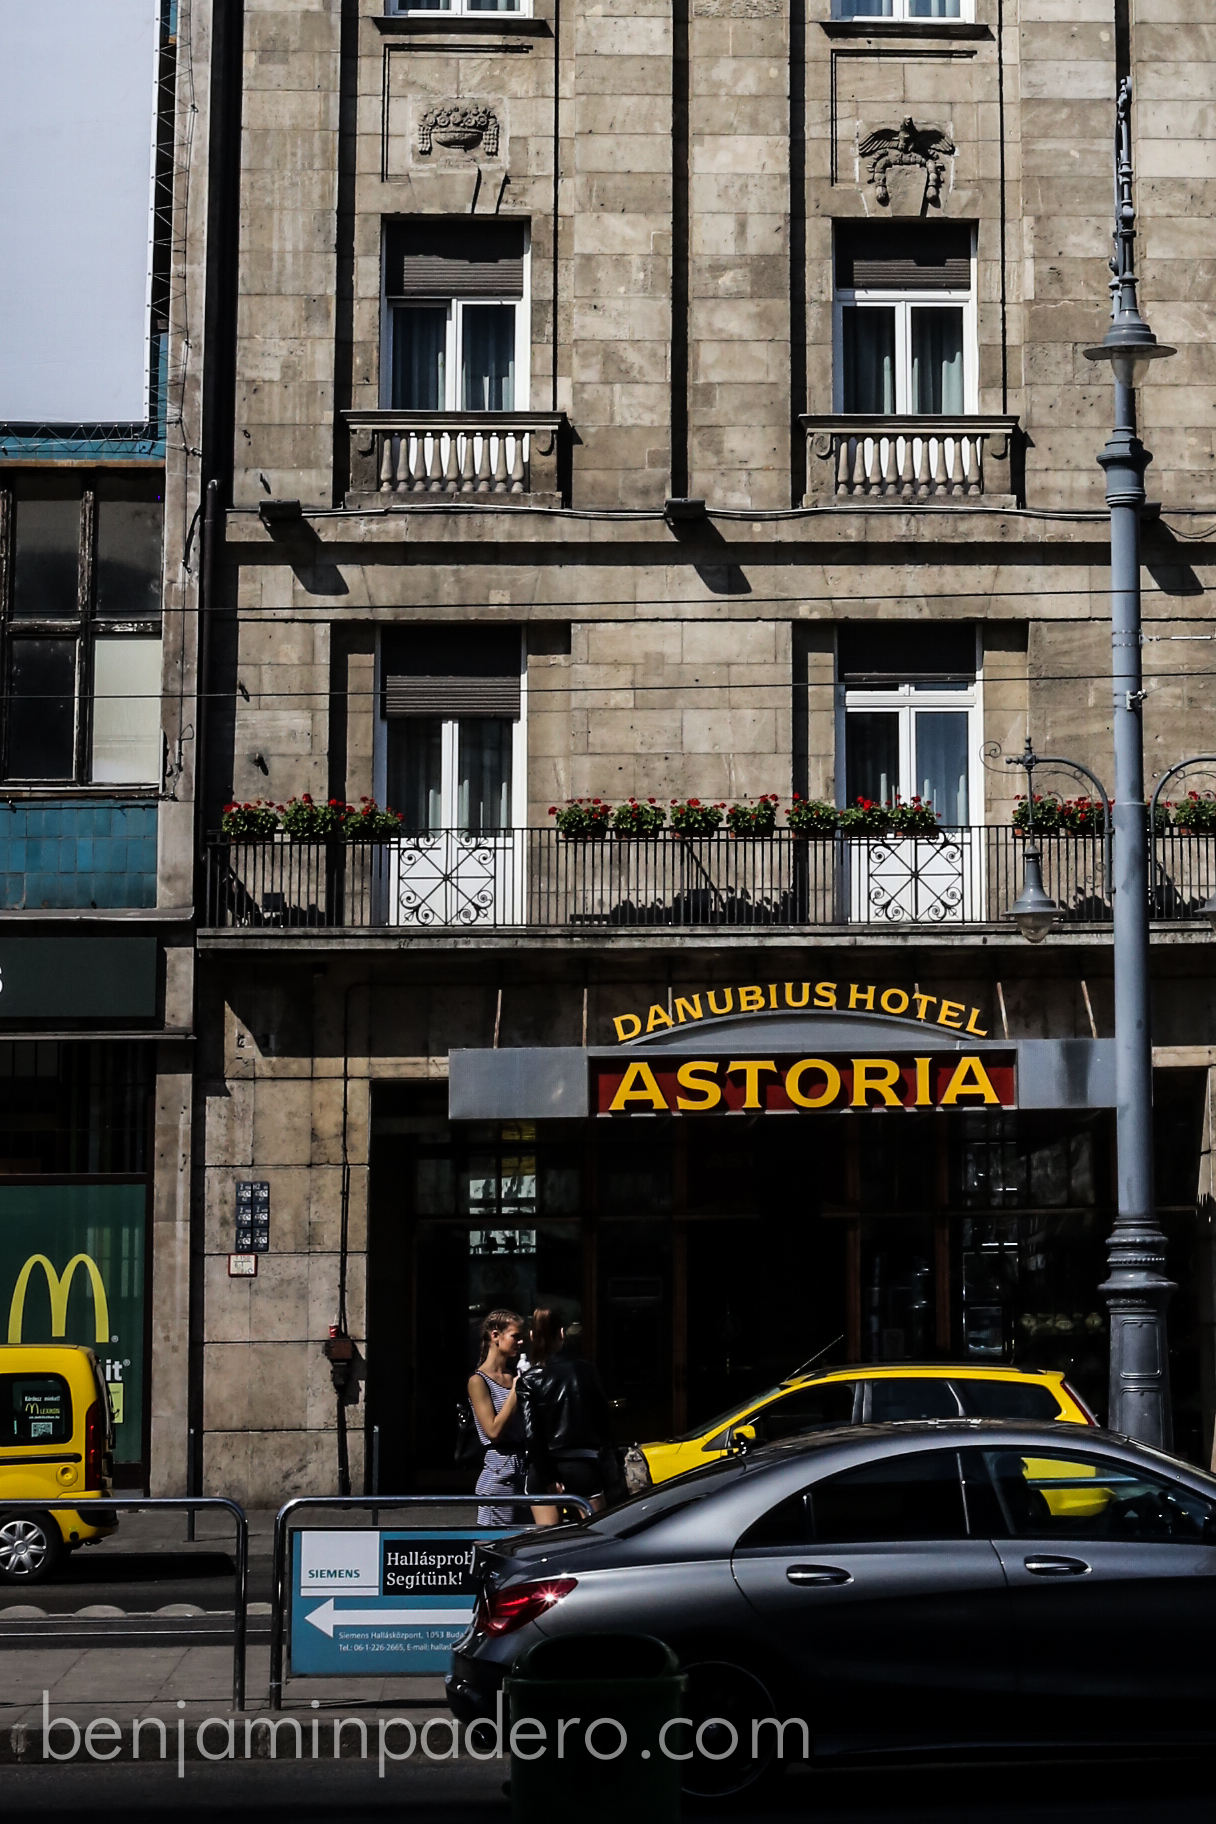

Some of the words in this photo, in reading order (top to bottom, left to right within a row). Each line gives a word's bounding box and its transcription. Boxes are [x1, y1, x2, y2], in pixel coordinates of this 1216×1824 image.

[611, 981, 838, 1043] DANUBIUS
[847, 983, 990, 1038] HOTEL
[606, 1055, 1001, 1111] ASTORIA
[308, 1568, 361, 1579] SIEMENS
[386, 1570, 463, 1589] Segítünk!
[338, 1631, 369, 1639] Siemens
[426, 1631, 444, 1639] 1053
